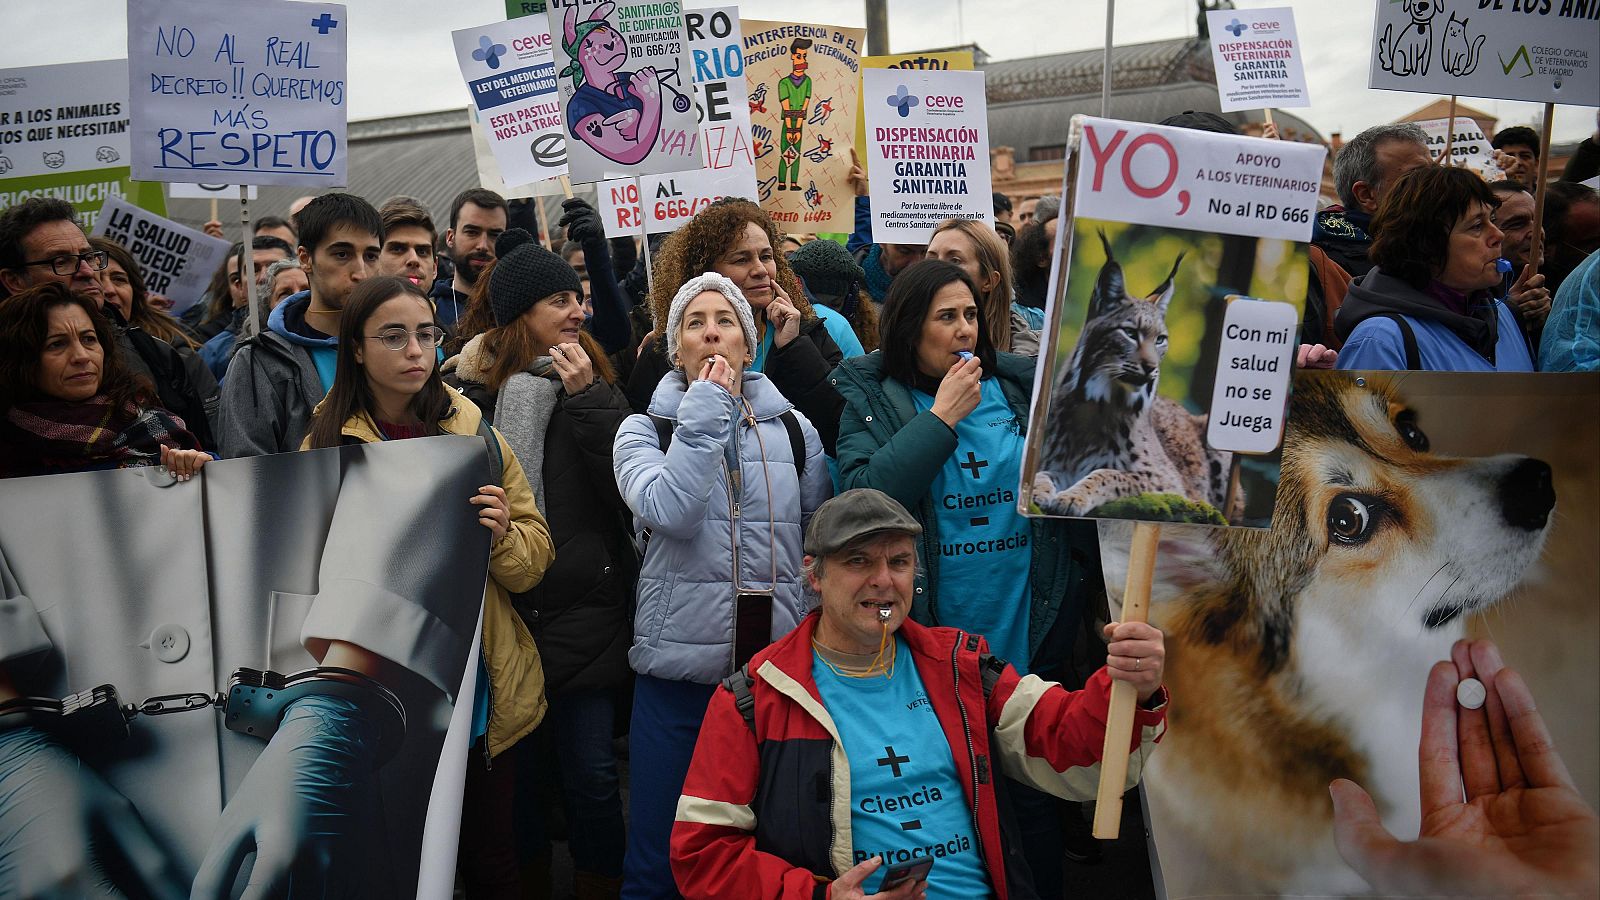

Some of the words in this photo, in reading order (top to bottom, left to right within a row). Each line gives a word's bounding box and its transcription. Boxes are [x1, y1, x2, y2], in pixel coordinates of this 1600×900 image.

[618, 1, 680, 20] SANITARI@S
[619, 21, 632, 33] DE
[632, 16, 682, 32] CONFIANZA
[1252, 21, 1280, 30] ceve
[512, 33, 552, 52] ceve
[629, 30, 679, 44] MODIFICACIÓN
[743, 25, 827, 49] INTERFERENCIA
[832, 32, 845, 44] EN
[846, 39, 858, 54] EL
[1218, 39, 1293, 52] DISPENSACIÓN
[156, 26, 195, 58] NO
[214, 33, 245, 66] AL
[266, 36, 320, 69] REAL
[630, 46, 643, 58] RD
[646, 42, 681, 57] 666/23
[1223, 50, 1291, 62] VETERINARIA
[1531, 46, 1561, 56] COLEGIO
[1563, 49, 1588, 59] OFICIAL
[692, 44, 744, 83] RIO
[1234, 59, 1286, 71] GARANTÍA
[1535, 56, 1543, 65] DE
[1545, 57, 1588, 69] VETERINARIOS
[1234, 70, 1288, 81] SANITARIA
[1538, 66, 1547, 75] DE
[1548, 67, 1574, 77] MADRID
[252, 72, 344, 105] QUEREMOS
[476, 81, 493, 94] LEY
[493, 77, 511, 89] DEL
[500, 78, 557, 99] VETERINARIO
[925, 95, 963, 108] ceve
[14, 111, 23, 124] A
[28, 108, 52, 123] LOS
[57, 102, 121, 120] ANIMALES
[213, 103, 268, 130] MÁS
[489, 112, 517, 128] ESTA
[27, 127, 53, 142] QUE
[494, 125, 518, 141] NOS
[518, 121, 533, 135] LA
[533, 114, 563, 130] TRAG
[875, 126, 979, 143] DISPENSACIÓN
[158, 128, 337, 171] RESPETO
[660, 128, 697, 157] YA!
[702, 125, 753, 170] IZA
[881, 144, 975, 160] VETERINARIA
[1235, 152, 1281, 169] APOYO
[895, 160, 967, 177] GARANTÍA
[1083, 125, 1191, 216] YO,
[893, 179, 968, 194] SANITARIA
[1196, 168, 1205, 181] A
[1208, 171, 1232, 183] LOS
[1234, 173, 1317, 193] VETERINARIOS
[610, 184, 638, 206] NO
[656, 179, 682, 198] AL
[880, 211, 927, 219] medicamentos
[901, 202, 912, 210] Por
[912, 202, 920, 210] la
[939, 202, 954, 210] libre
[954, 202, 963, 211] de
[1208, 198, 1231, 216] No
[1236, 201, 1250, 219] al
[1255, 204, 1277, 220] RD
[1281, 207, 1310, 224] 666
[804, 209, 832, 222] 666/23
[885, 220, 909, 228] Centros
[109, 208, 134, 233] LA
[134, 219, 192, 256] SALUD
[131, 240, 186, 277] PUEDE
[1226, 324, 1261, 342] Con
[1266, 328, 1289, 344] mi
[1230, 354, 1279, 373] salud
[1225, 385, 1248, 399] no
[1252, 387, 1272, 401] se
[1219, 410, 1272, 433] Juega
[943, 488, 1015, 510] Ciencia
[860, 785, 943, 813] Ciencia
